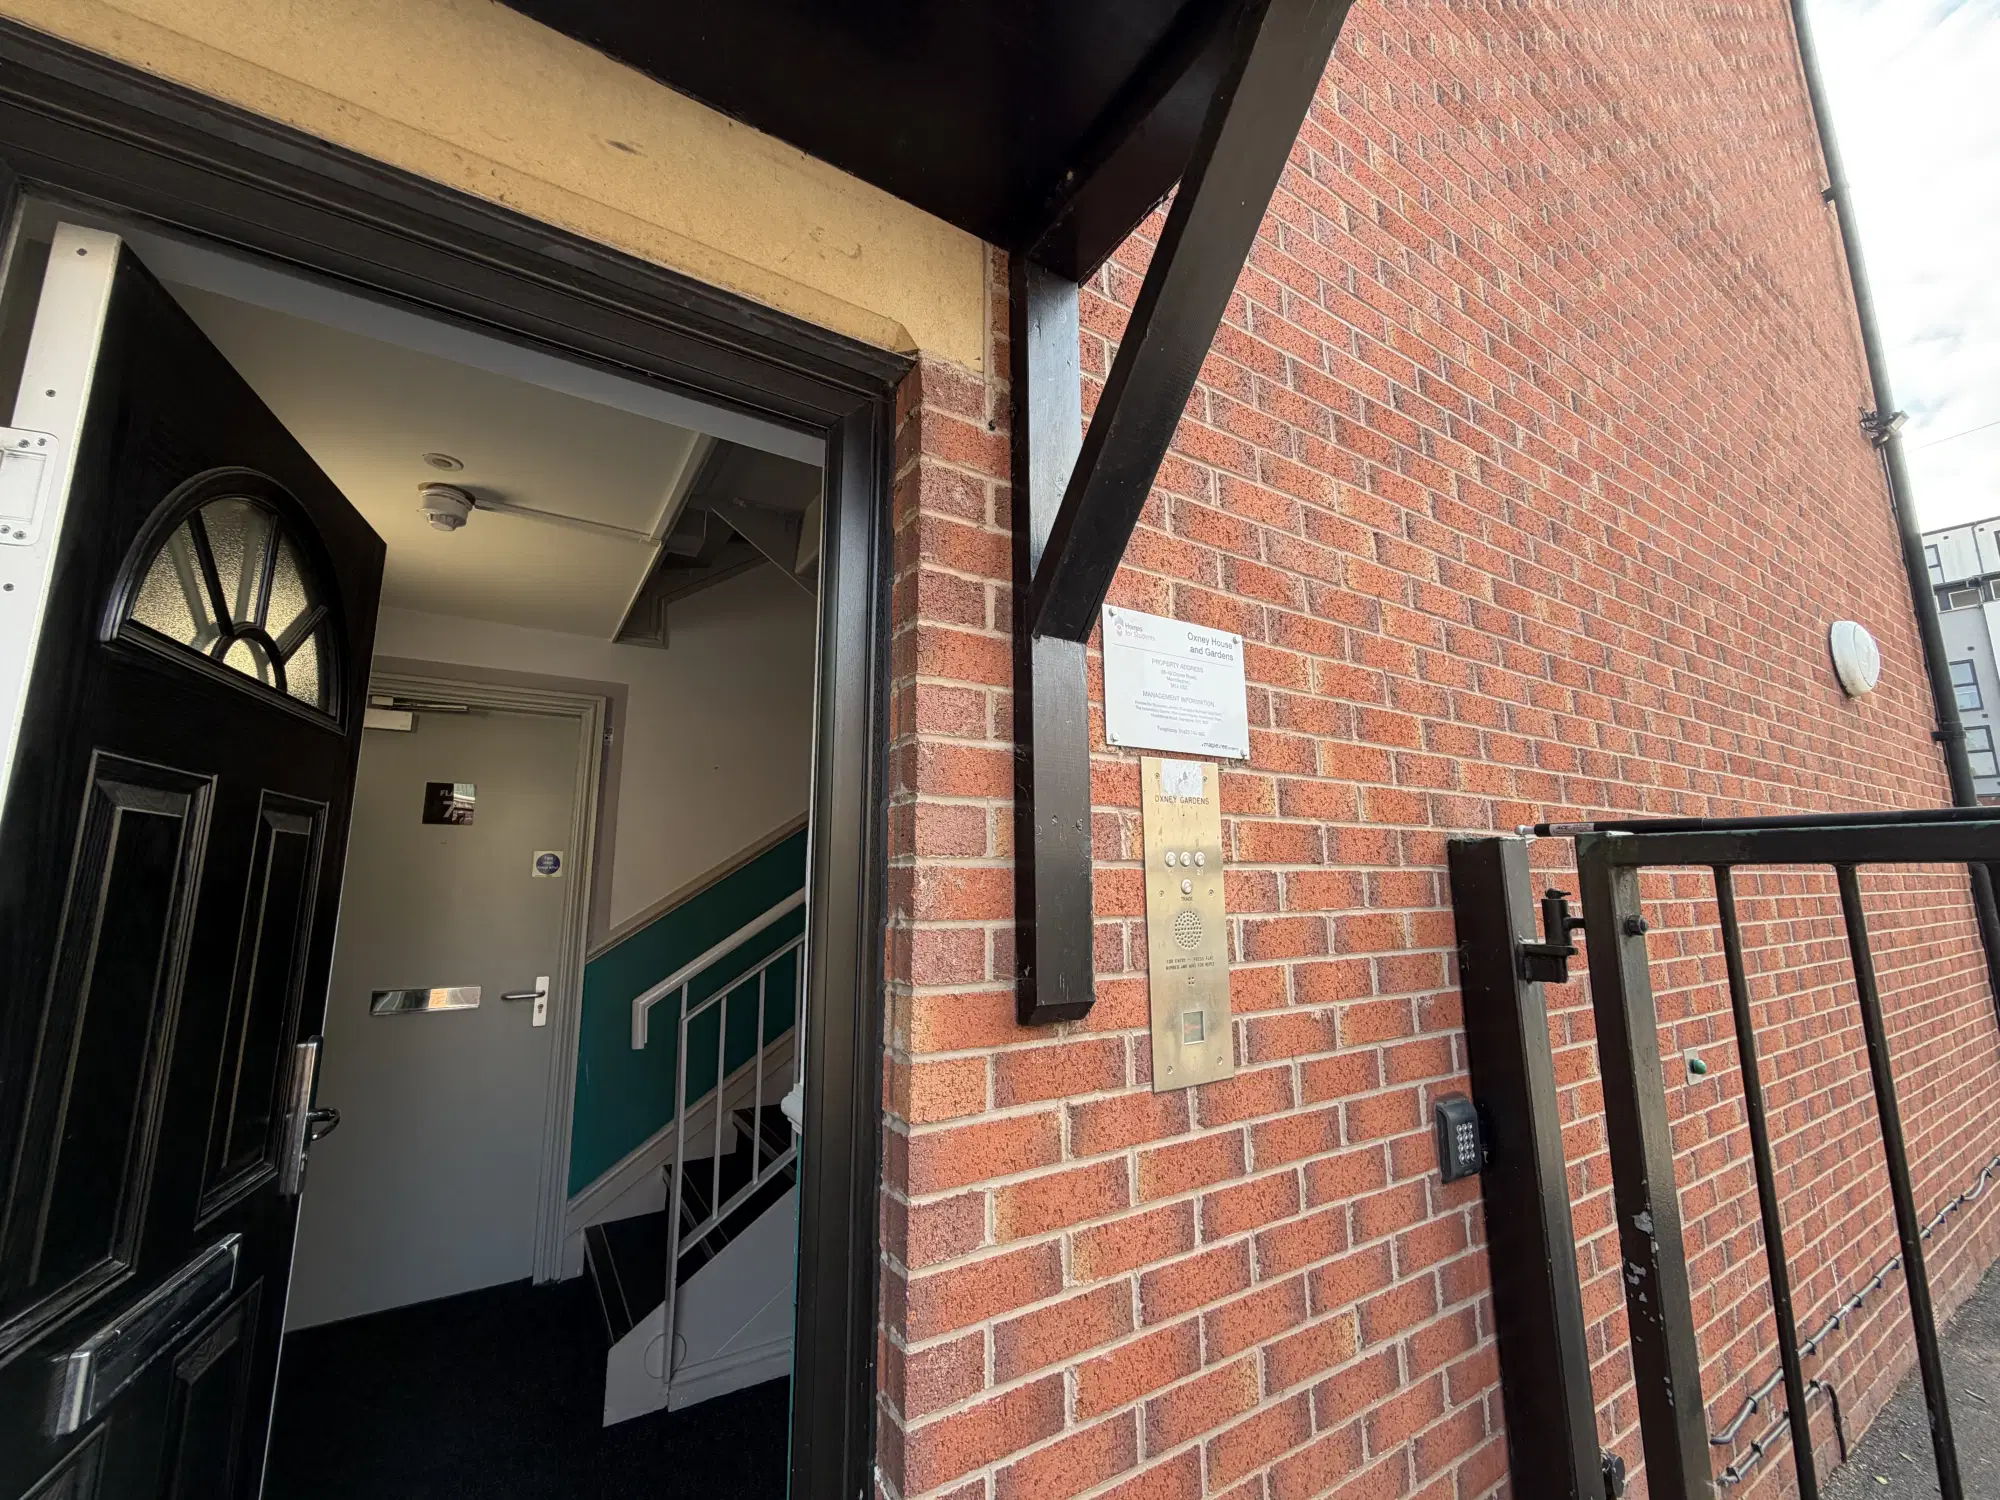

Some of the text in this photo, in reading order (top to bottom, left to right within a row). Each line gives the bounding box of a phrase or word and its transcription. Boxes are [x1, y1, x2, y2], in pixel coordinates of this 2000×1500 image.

[1187, 631, 1233, 650] Oxney House
[1190, 646, 1234, 661] and Gardens
[1151, 658, 1204, 673] PROPERTY ADDRESS
[1142, 690, 1215, 707] MANAGEMENT INFORMATION
[1154, 795, 1210, 806] OXNEY GARDENS
